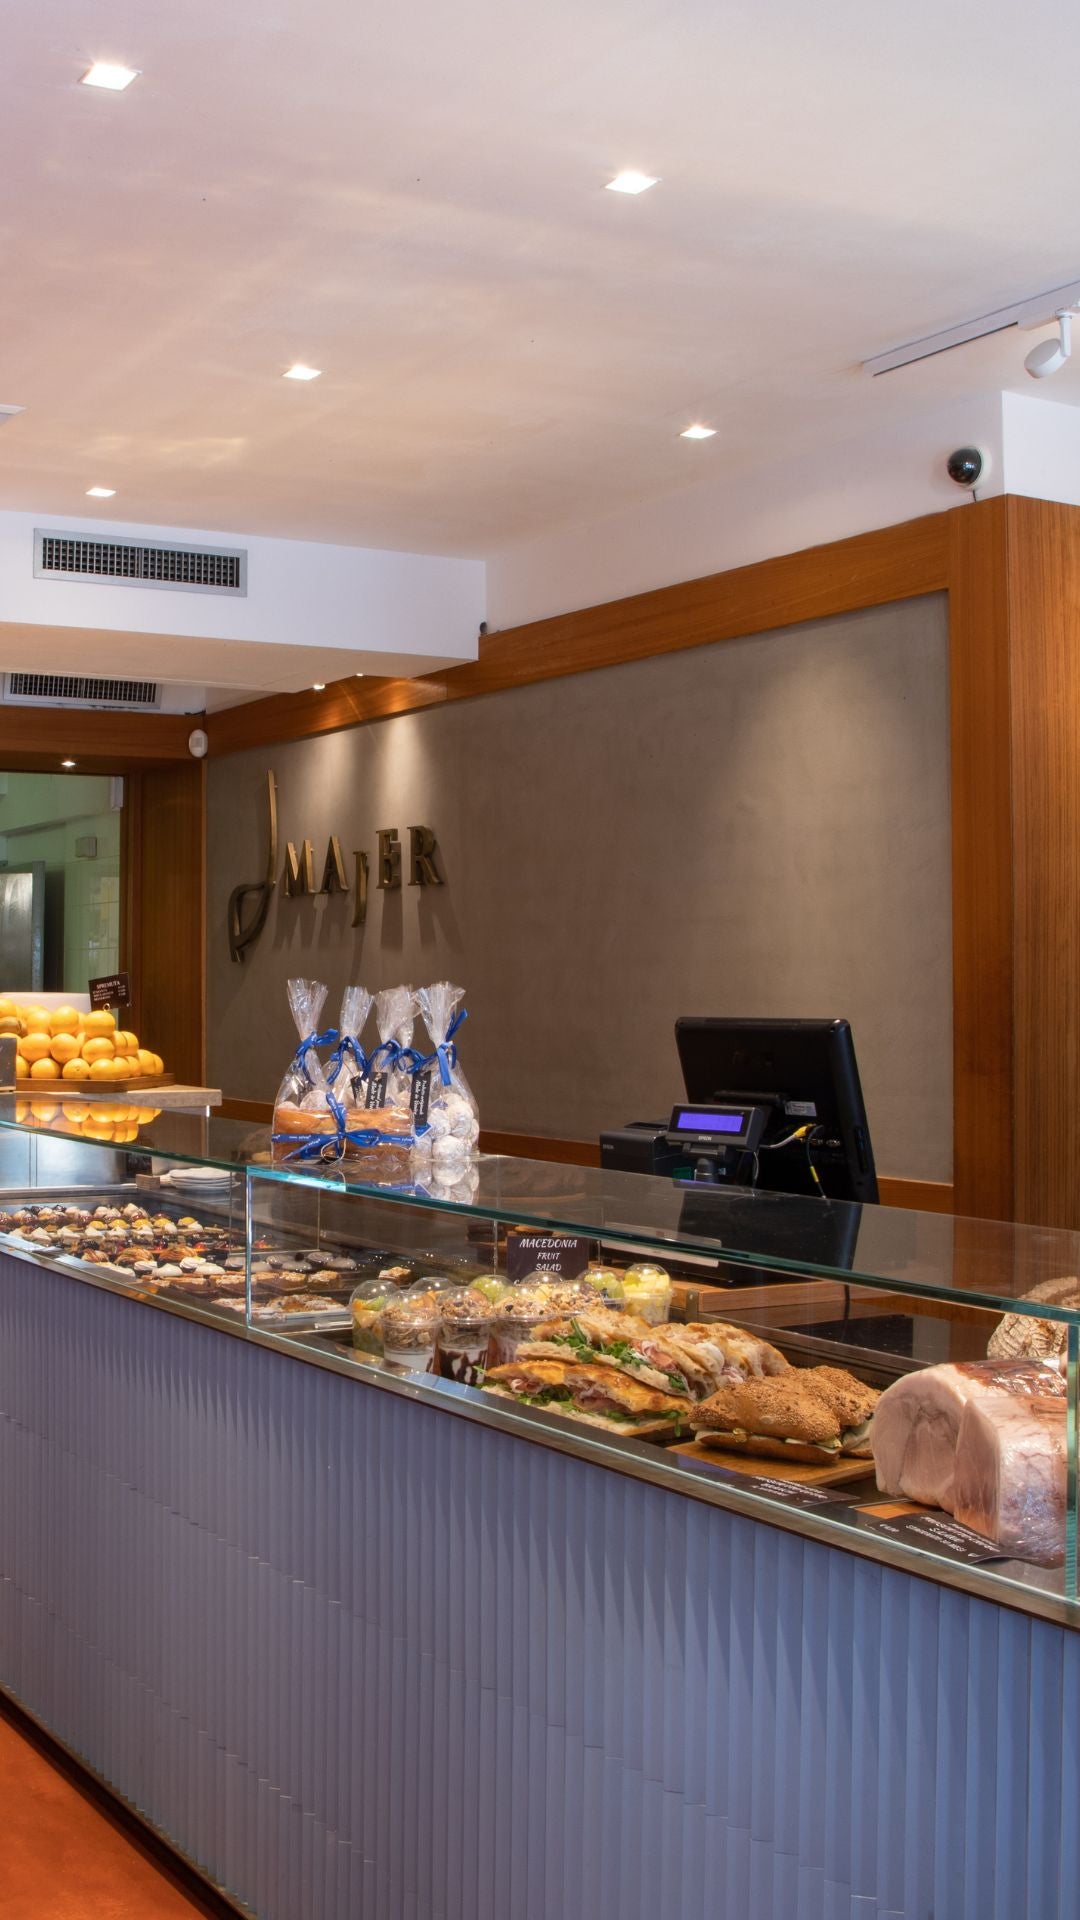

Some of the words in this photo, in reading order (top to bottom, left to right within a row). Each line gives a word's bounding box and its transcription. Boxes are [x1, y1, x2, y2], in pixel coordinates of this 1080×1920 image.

[519, 1238, 578, 1249] MACEDONIA
[536, 1252, 561, 1261] FRUIT
[535, 1263, 562, 1272] SALAD
